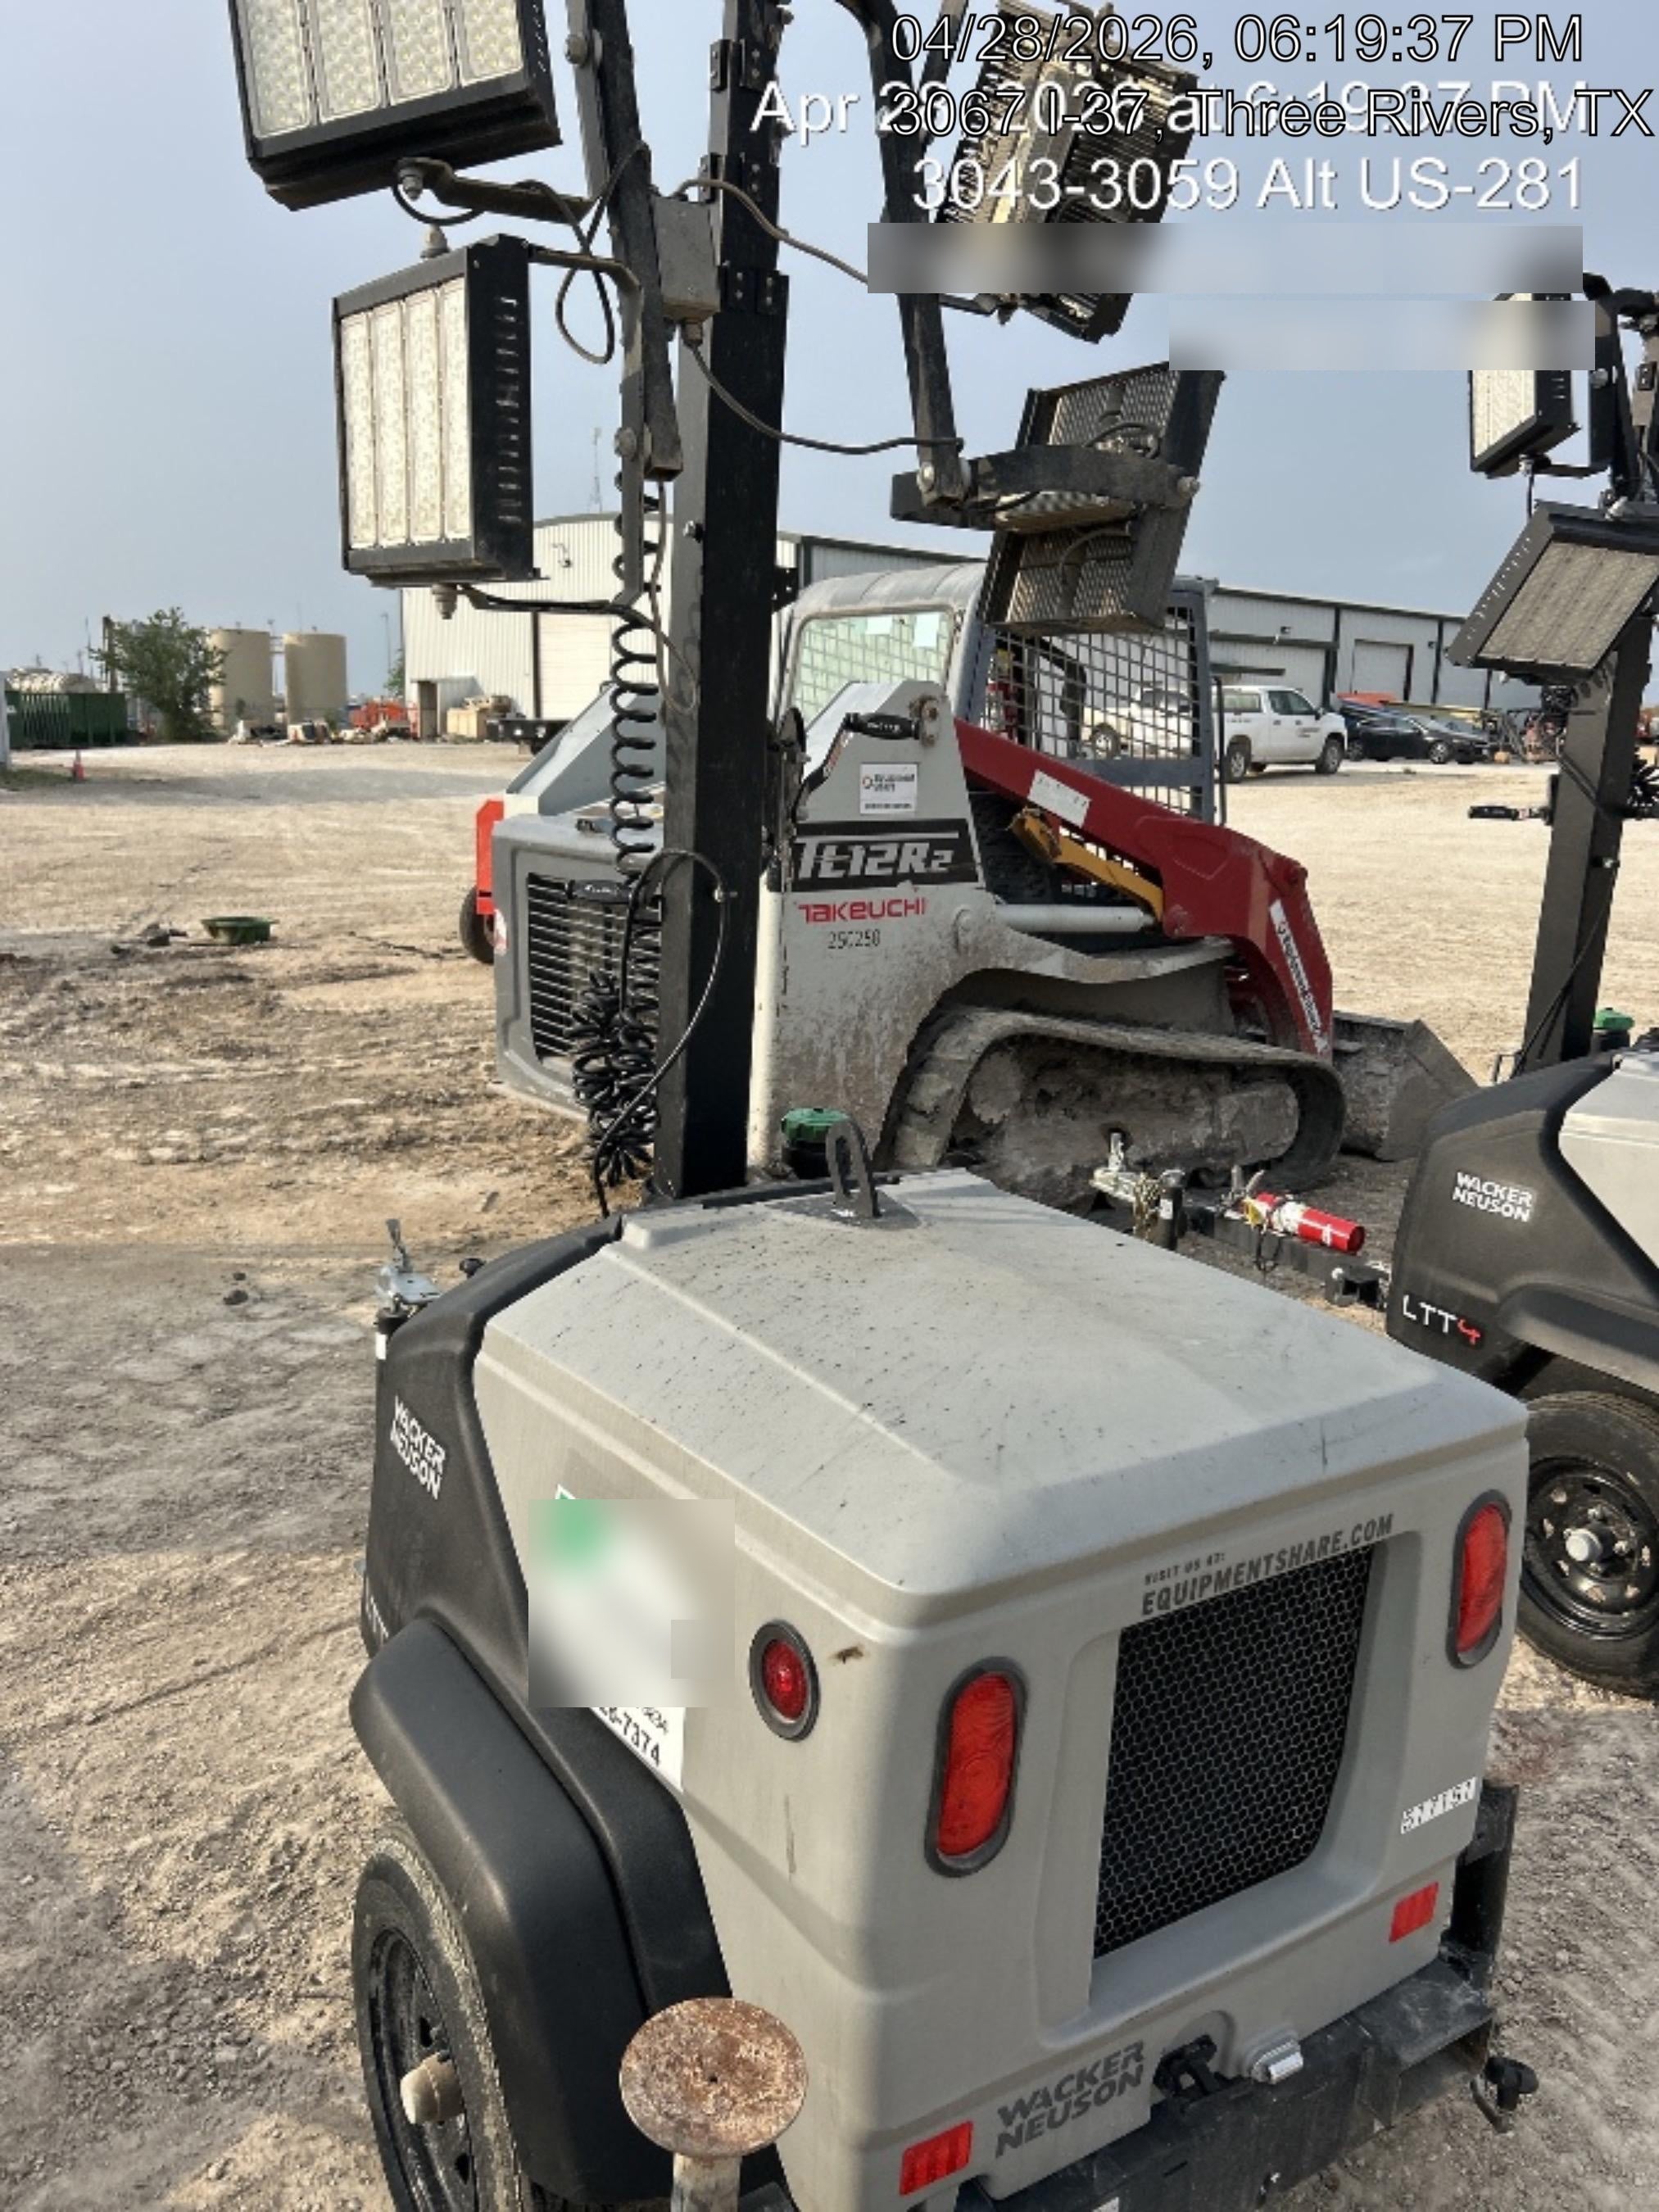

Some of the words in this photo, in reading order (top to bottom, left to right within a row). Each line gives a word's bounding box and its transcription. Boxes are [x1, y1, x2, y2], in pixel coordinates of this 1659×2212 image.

[1452, 1188, 1530, 1222] NEUSON
[1457, 1172, 1532, 1208] WACKER
[390, 1420, 442, 1499] NEUSON
[395, 1395, 445, 1475] WACKER
[1142, 1513, 1394, 1616] EQUIPMENTSHARE.COM
[995, 2063, 1144, 2159] NEUSON
[997, 2039, 1145, 2127] WACKER
